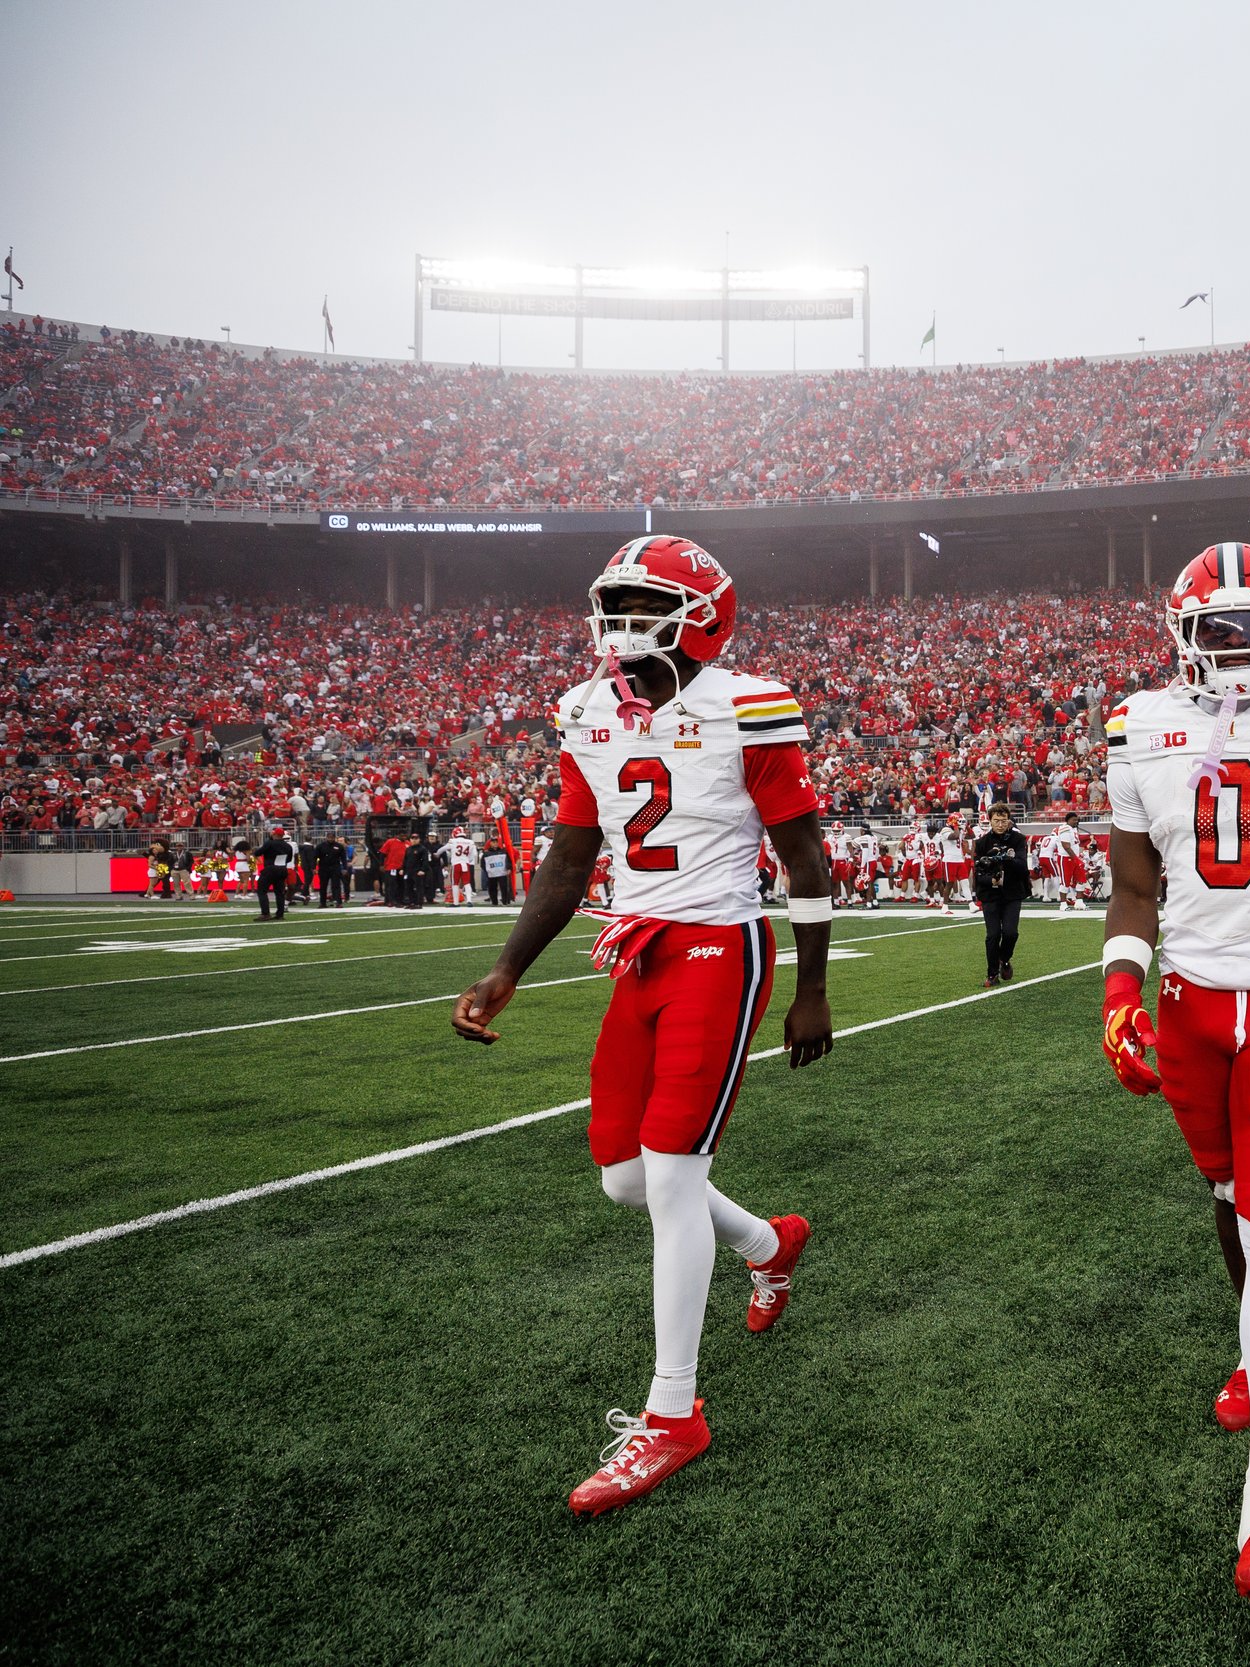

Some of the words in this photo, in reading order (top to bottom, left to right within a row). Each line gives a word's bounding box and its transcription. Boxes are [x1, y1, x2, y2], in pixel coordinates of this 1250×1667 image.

[436, 293, 501, 309] DEFEND
[504, 296, 536, 311] THE
[784, 303, 849, 316] ANDURIL
[331, 517, 346, 526] CC
[418, 523, 446, 532] KALEB
[476, 523, 497, 532] AND
[509, 523, 542, 532] NAHSIR
[618, 757, 678, 871] 2
[455, 845, 470, 857] 34
[686, 946, 725, 960] Terps
